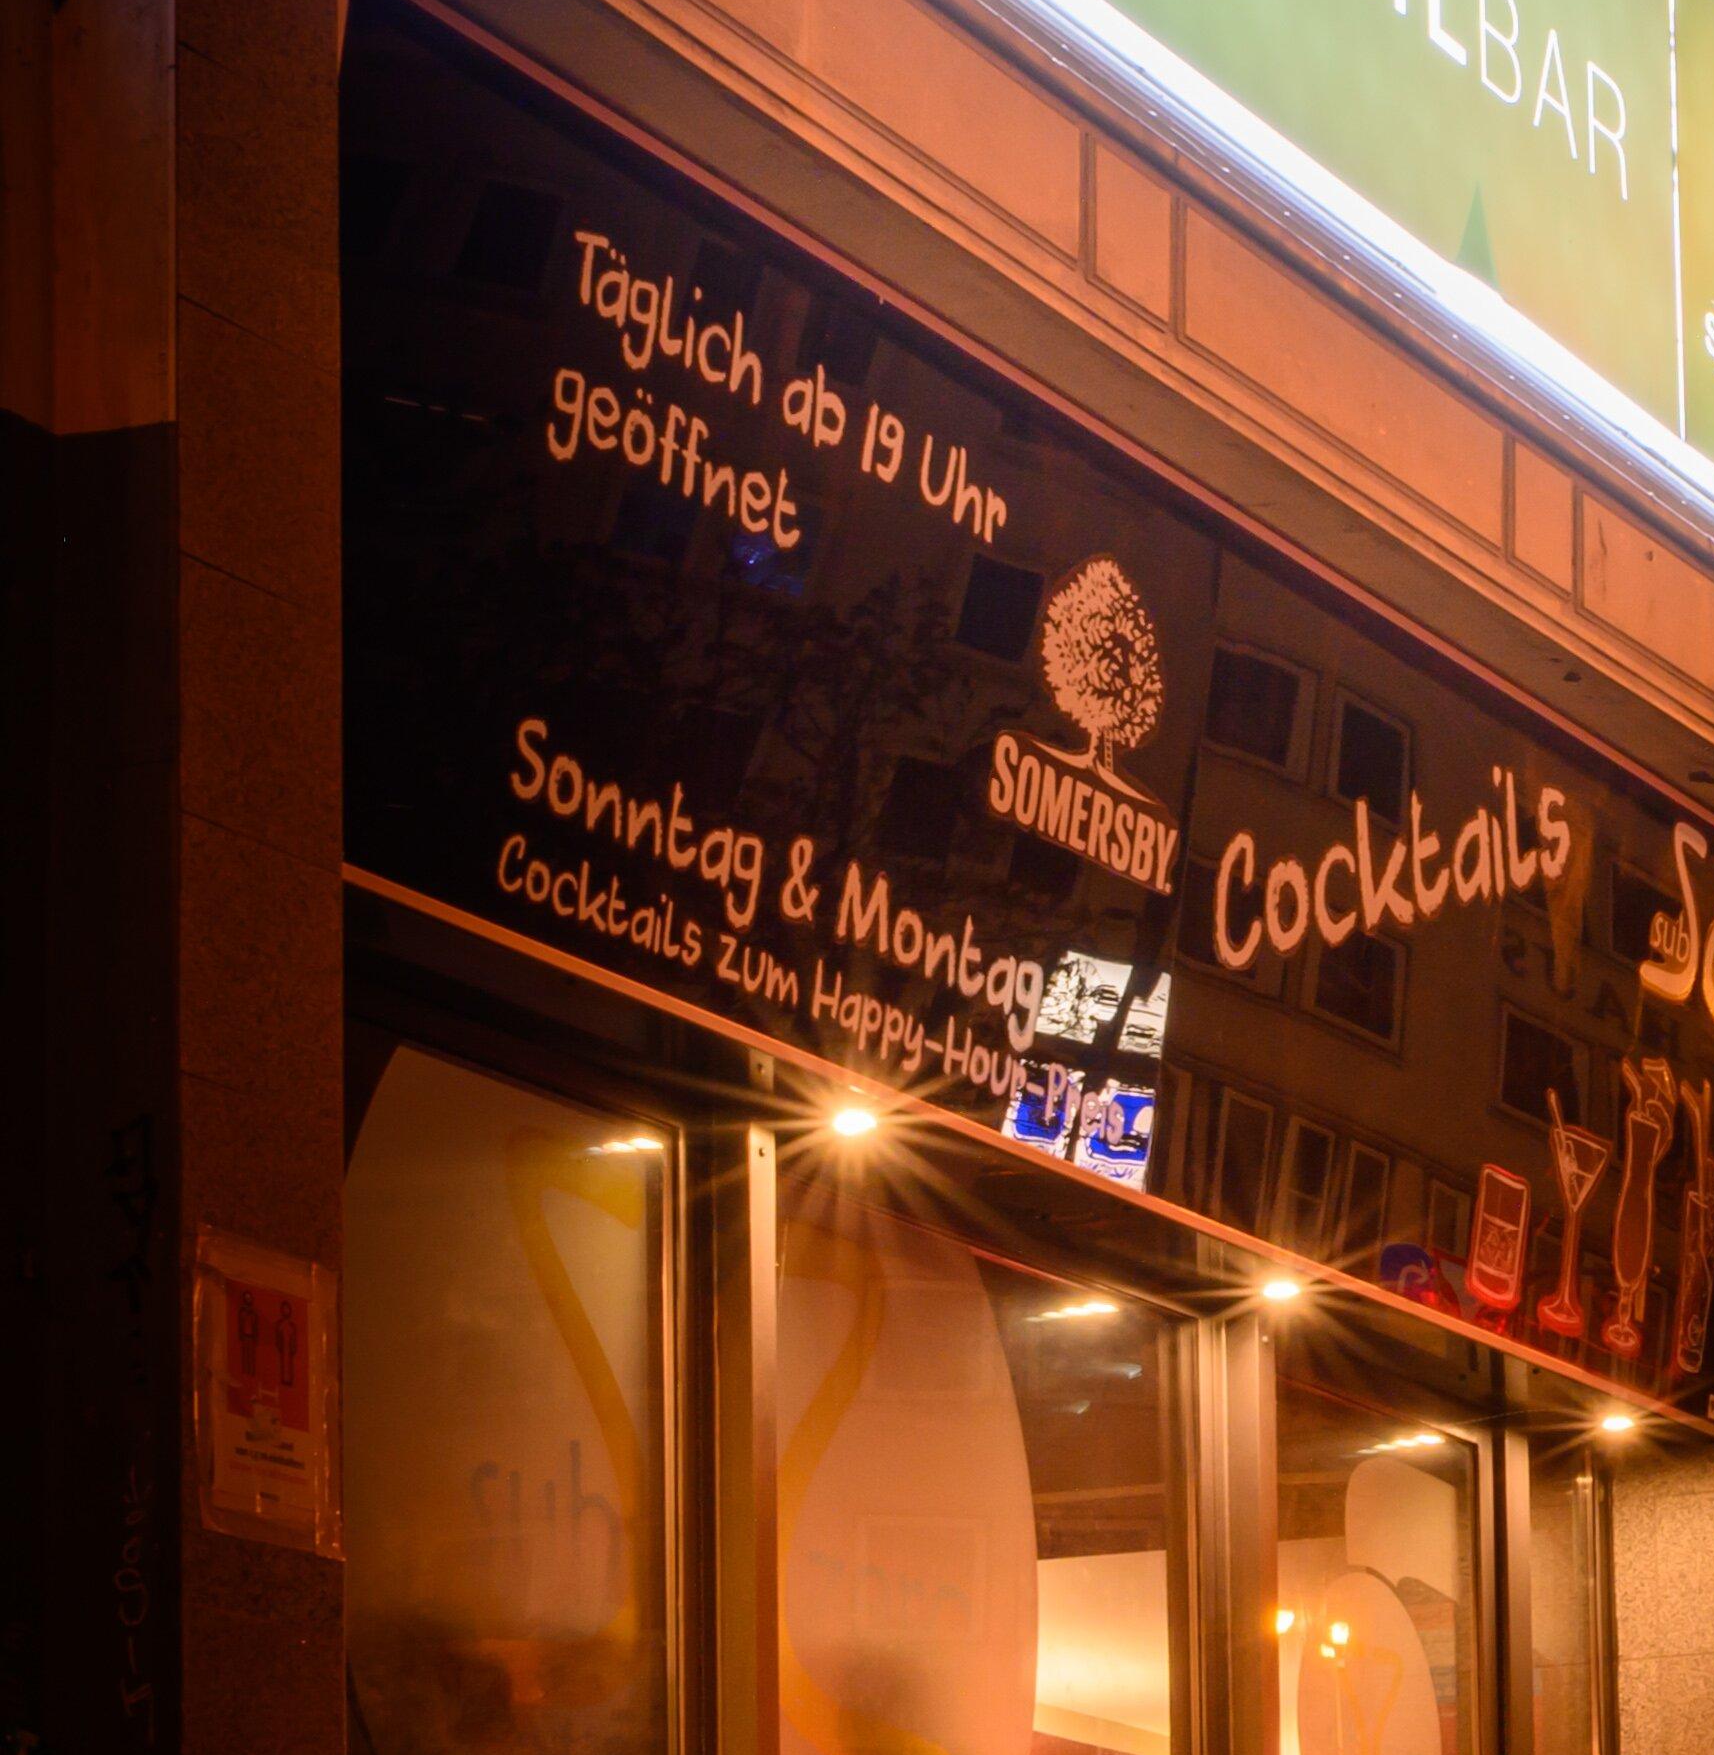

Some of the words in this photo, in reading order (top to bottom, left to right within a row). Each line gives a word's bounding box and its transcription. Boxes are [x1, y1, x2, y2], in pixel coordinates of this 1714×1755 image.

[546, 367, 801, 550] geöffnet
[573, 229, 763, 406] Täglich
[781, 363, 847, 448] ab
[860, 402, 905, 484] 19
[919, 433, 1007, 544] Uhr
[498, 834, 702, 967] Cocktails
[715, 933, 799, 1007] zum
[510, 717, 765, 929] Sonntag
[780, 837, 820, 923] &
[835, 859, 1045, 1053] Montag
[1212, 765, 1572, 972] Cocktails
